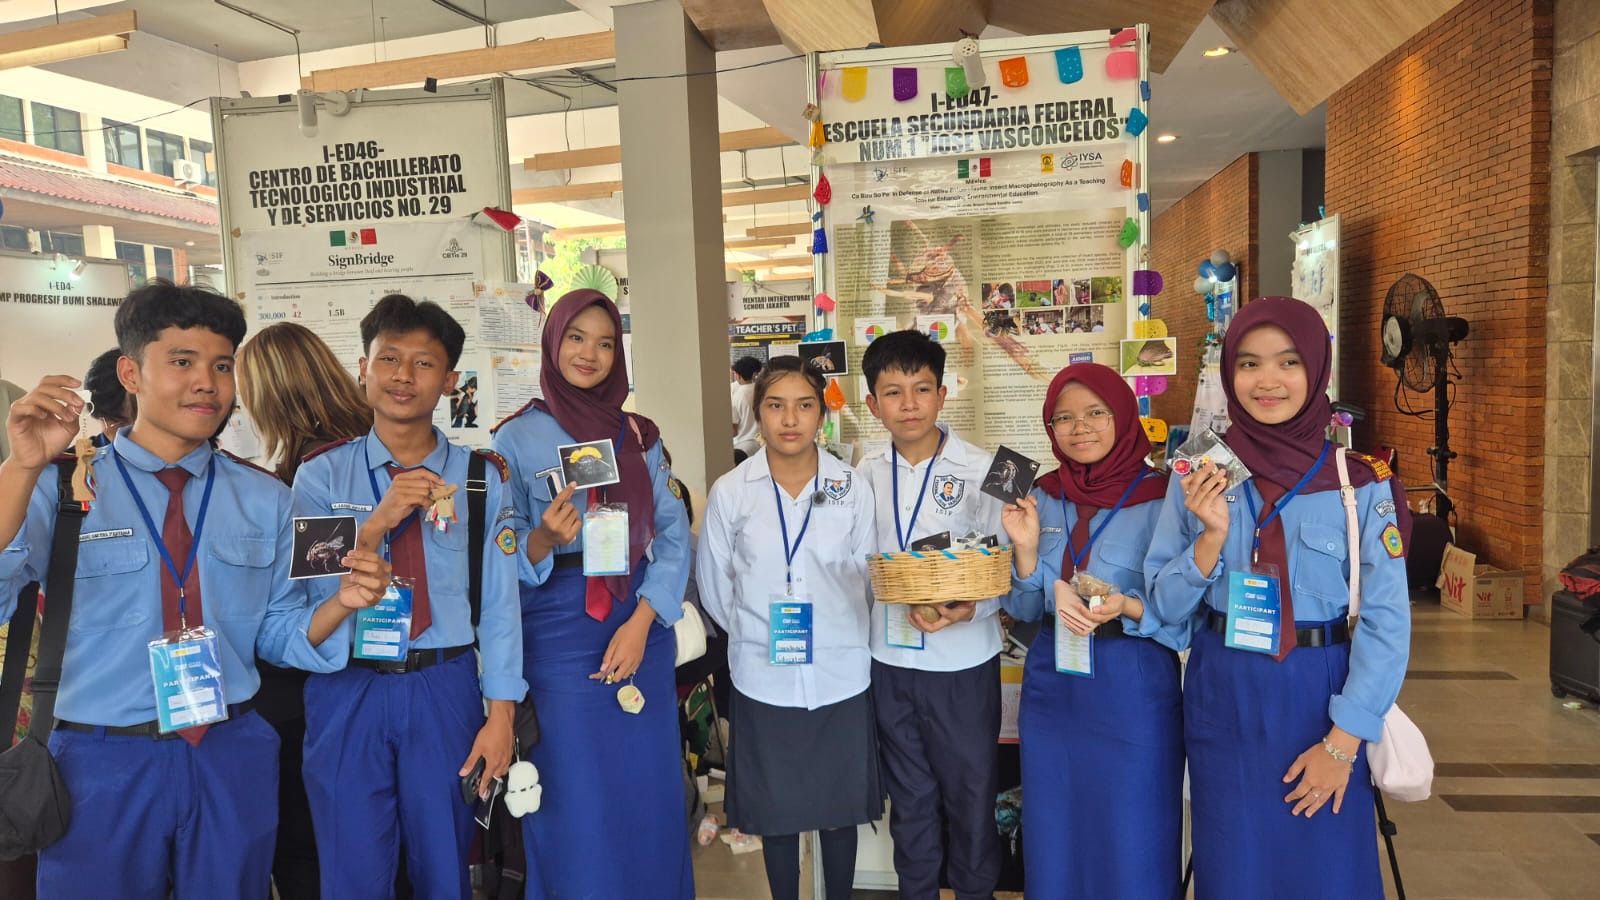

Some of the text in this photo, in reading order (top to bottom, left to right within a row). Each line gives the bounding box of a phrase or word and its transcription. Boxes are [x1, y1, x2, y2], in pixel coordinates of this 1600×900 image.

[823, 97, 1117, 143] ESCUELA SECUNDARIA FEDERAL
[323, 140, 384, 163] I-ED46-
[1079, 152, 1103, 161] IYSA
[249, 153, 461, 189] CENTRO DE BACHILLERATO
[249, 174, 466, 208] TECNOLOGICO INDUSTRIAL
[898, 189, 923, 197] Defense
[1008, 180, 1064, 190] Macrophotography
[1079, 177, 1106, 185] Teaching
[1008, 190, 1038, 198] Education
[267, 196, 452, 226] Y DE SERVICIOS NO. 29
[328, 250, 394, 270] SignBridge
[13, 293, 61, 305] PROGRESIF
[62, 296, 85, 305] BUMI
[735, 323, 797, 334] TEACHER'S PET
[1234, 603, 1277, 615] PARTICIPANT
